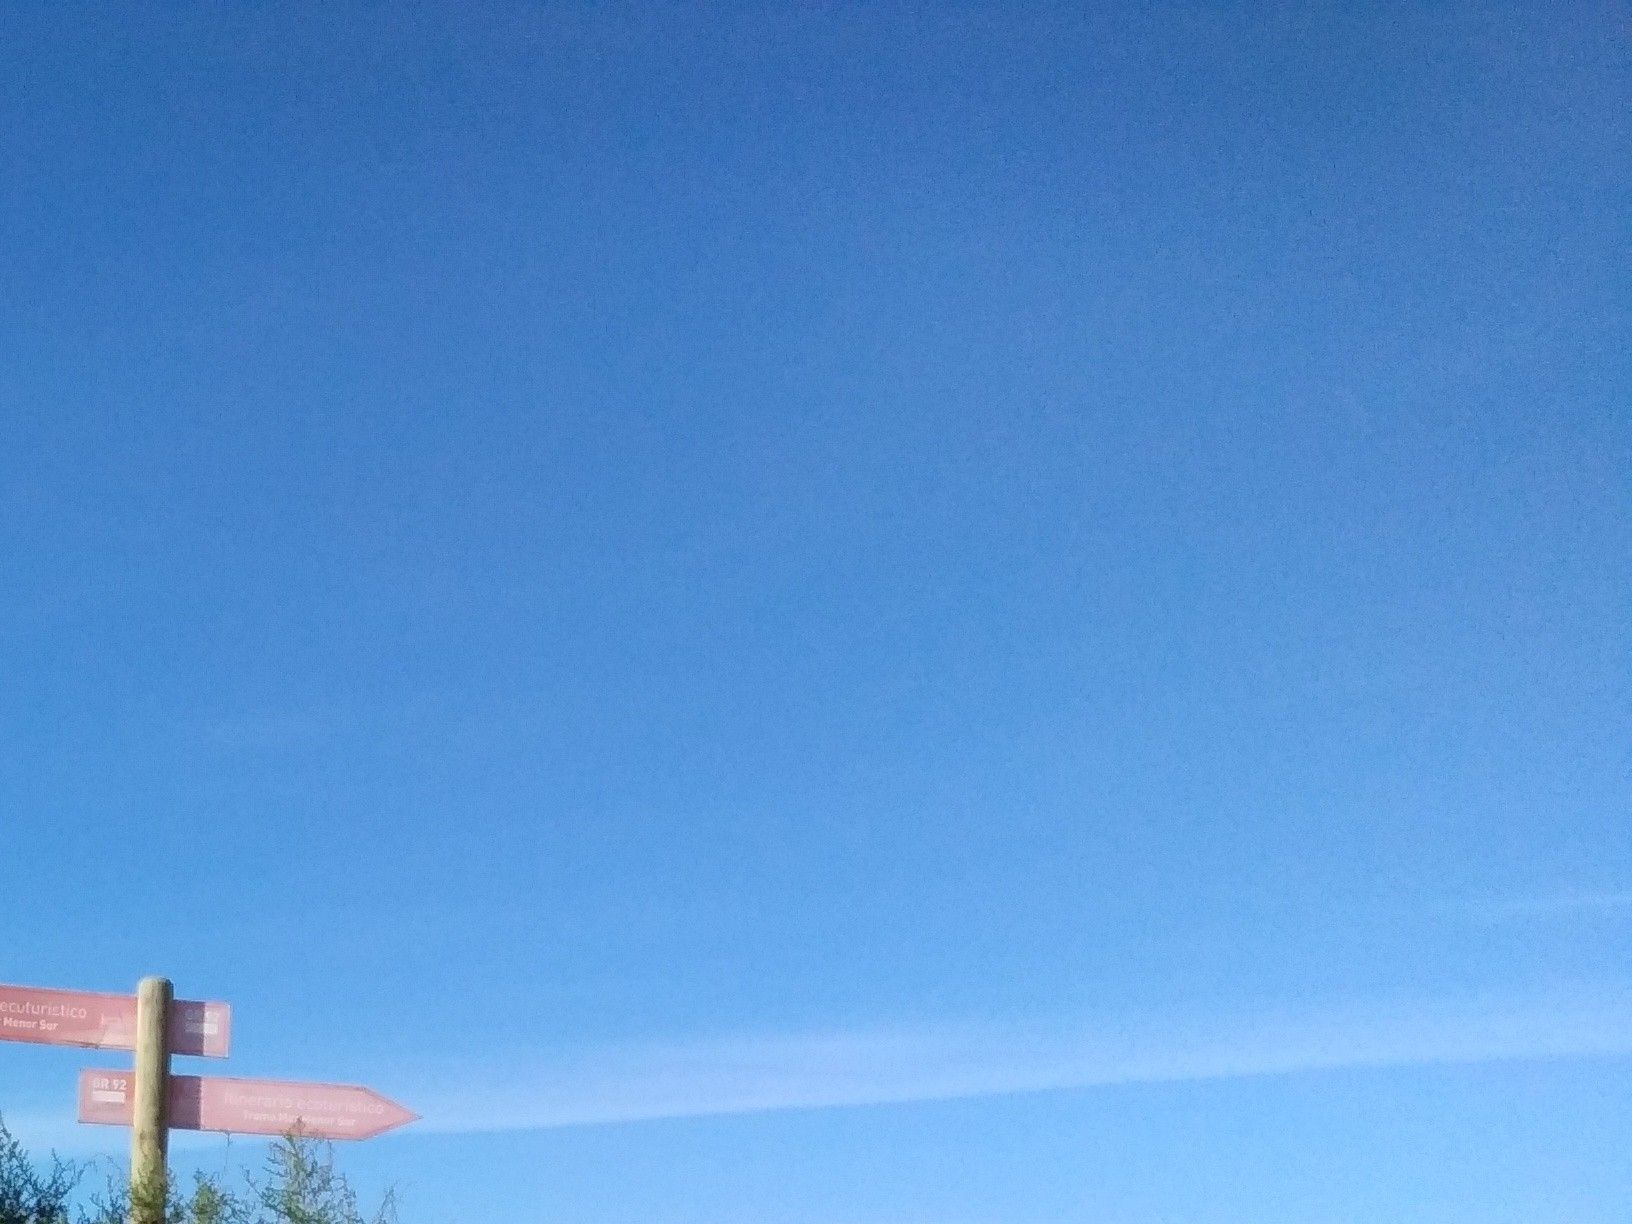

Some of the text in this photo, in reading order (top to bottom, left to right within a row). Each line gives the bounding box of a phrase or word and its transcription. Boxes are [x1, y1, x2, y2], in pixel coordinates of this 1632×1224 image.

[3, 1016, 37, 1028] Menor
[39, 1019, 58, 1031] Sur
[112, 1079, 127, 1091] 92
